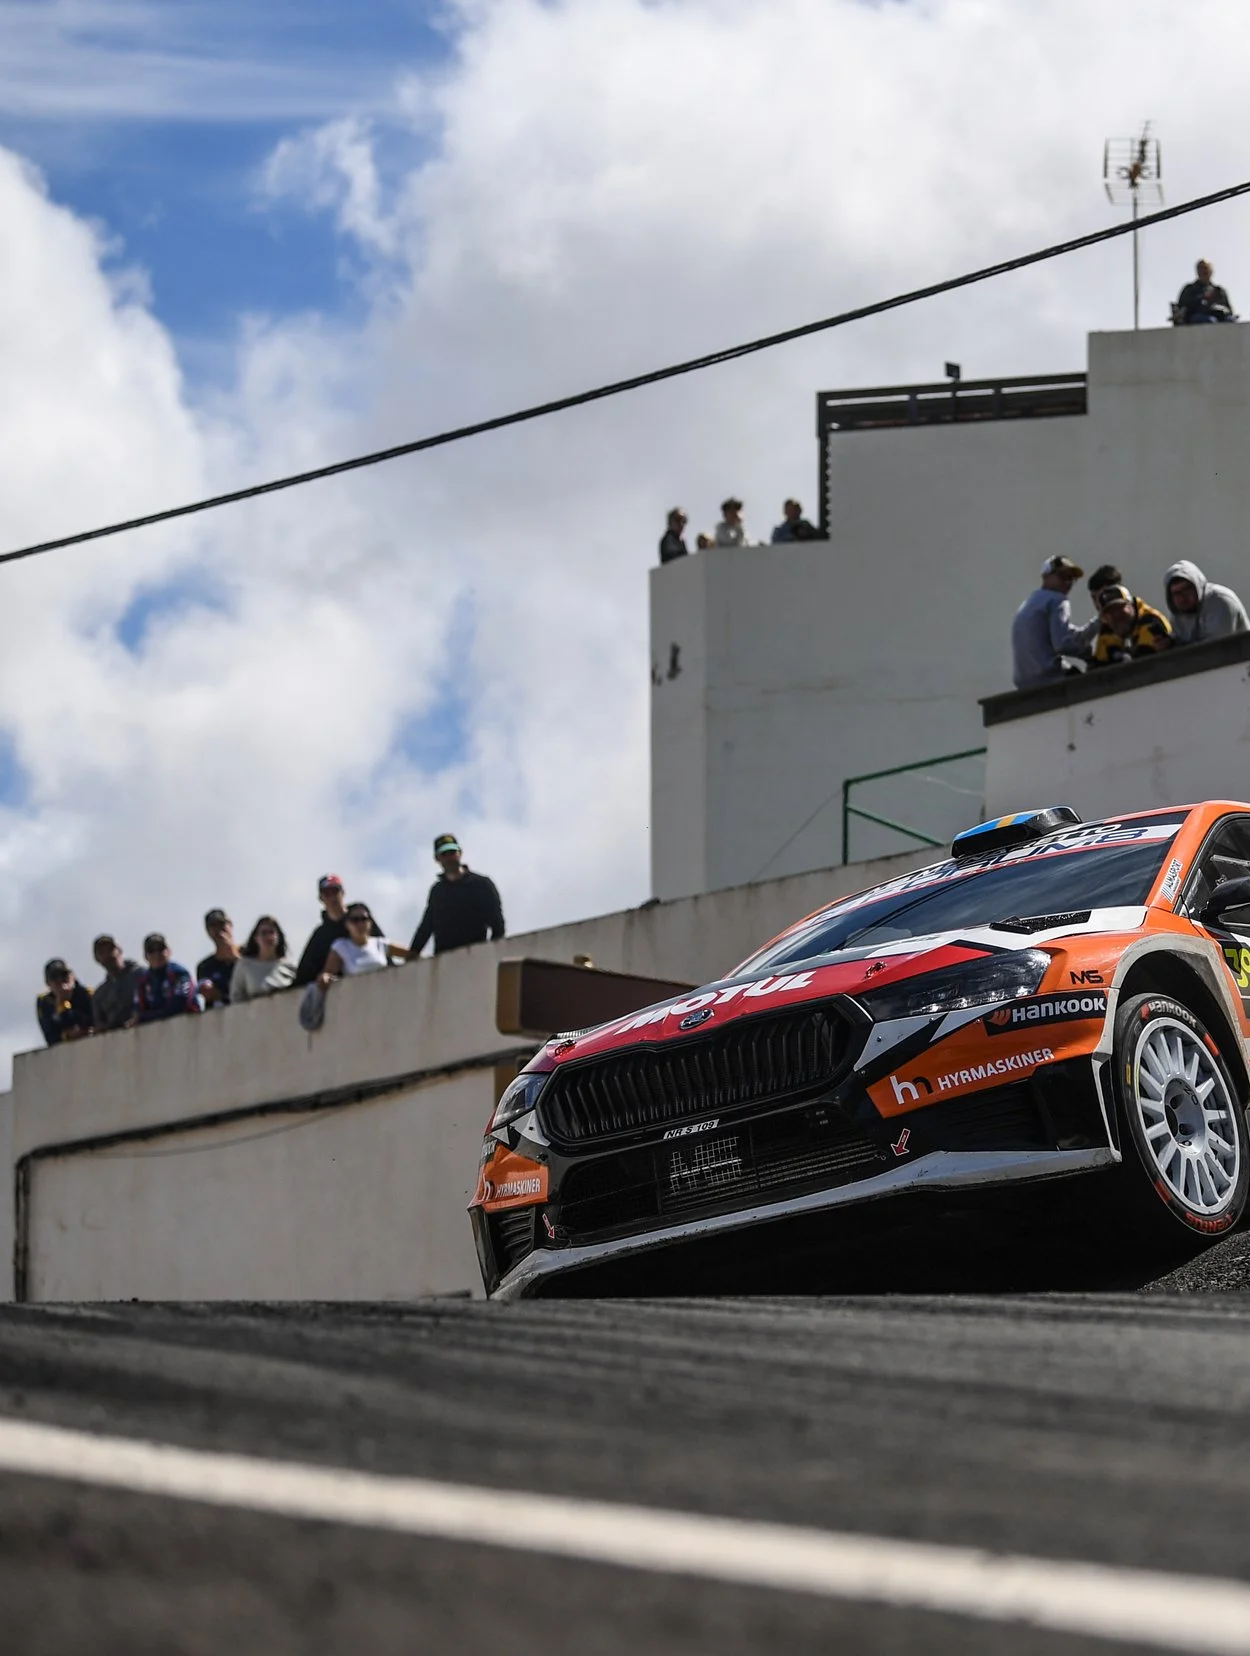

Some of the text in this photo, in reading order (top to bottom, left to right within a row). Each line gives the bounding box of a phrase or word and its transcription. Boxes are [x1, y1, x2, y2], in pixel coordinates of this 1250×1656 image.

[614, 970, 817, 1036] MOTUL
[937, 1047, 1055, 1091] HYRMASKINER
[667, 1129, 684, 1138] NR
[696, 1121, 715, 1132] 109
